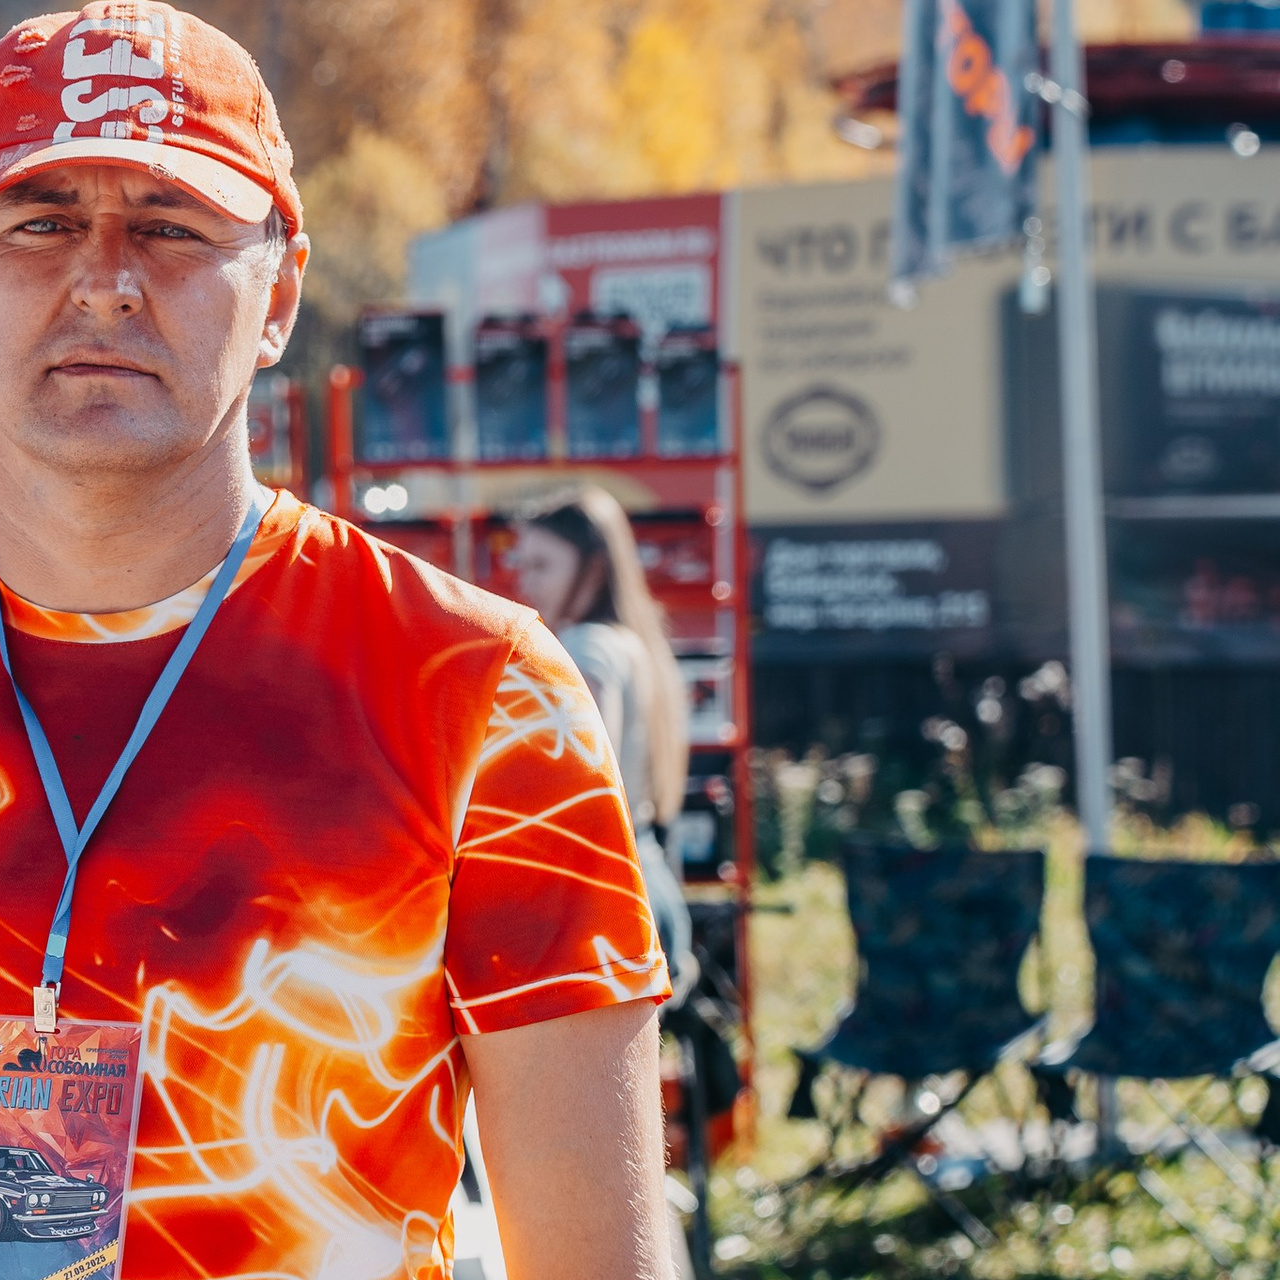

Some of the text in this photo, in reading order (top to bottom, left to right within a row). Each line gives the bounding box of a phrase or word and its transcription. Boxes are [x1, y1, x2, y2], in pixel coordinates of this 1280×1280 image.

[50, 1046, 82, 1061] ГОРА
[48, 1060, 126, 1077] СОБОЛИНАЯ
[60, 1080, 124, 1115] EXPO
[64, 1254, 107, 1280] 27.09.2025
